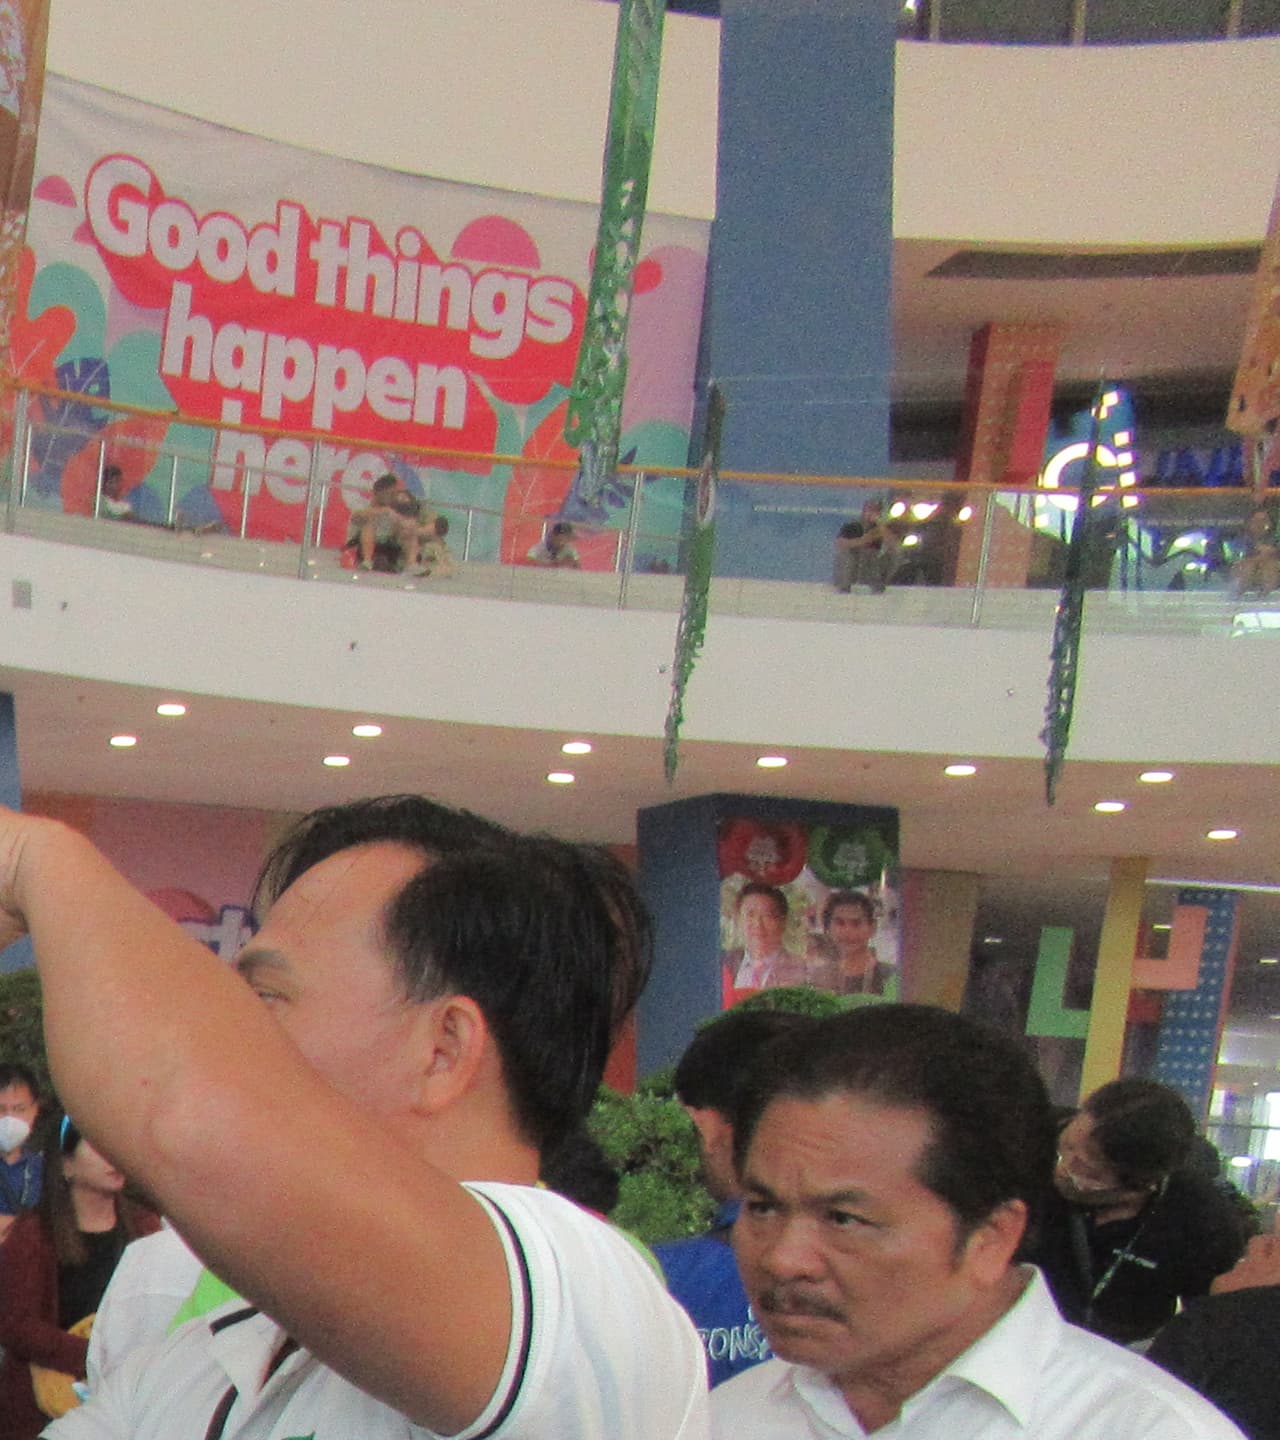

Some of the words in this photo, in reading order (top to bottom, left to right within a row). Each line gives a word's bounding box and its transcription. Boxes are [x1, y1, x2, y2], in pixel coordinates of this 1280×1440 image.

[87, 156, 303, 298] Good
[309, 213, 574, 357] things
[162, 280, 468, 430] happen
[211, 397, 390, 512] here
